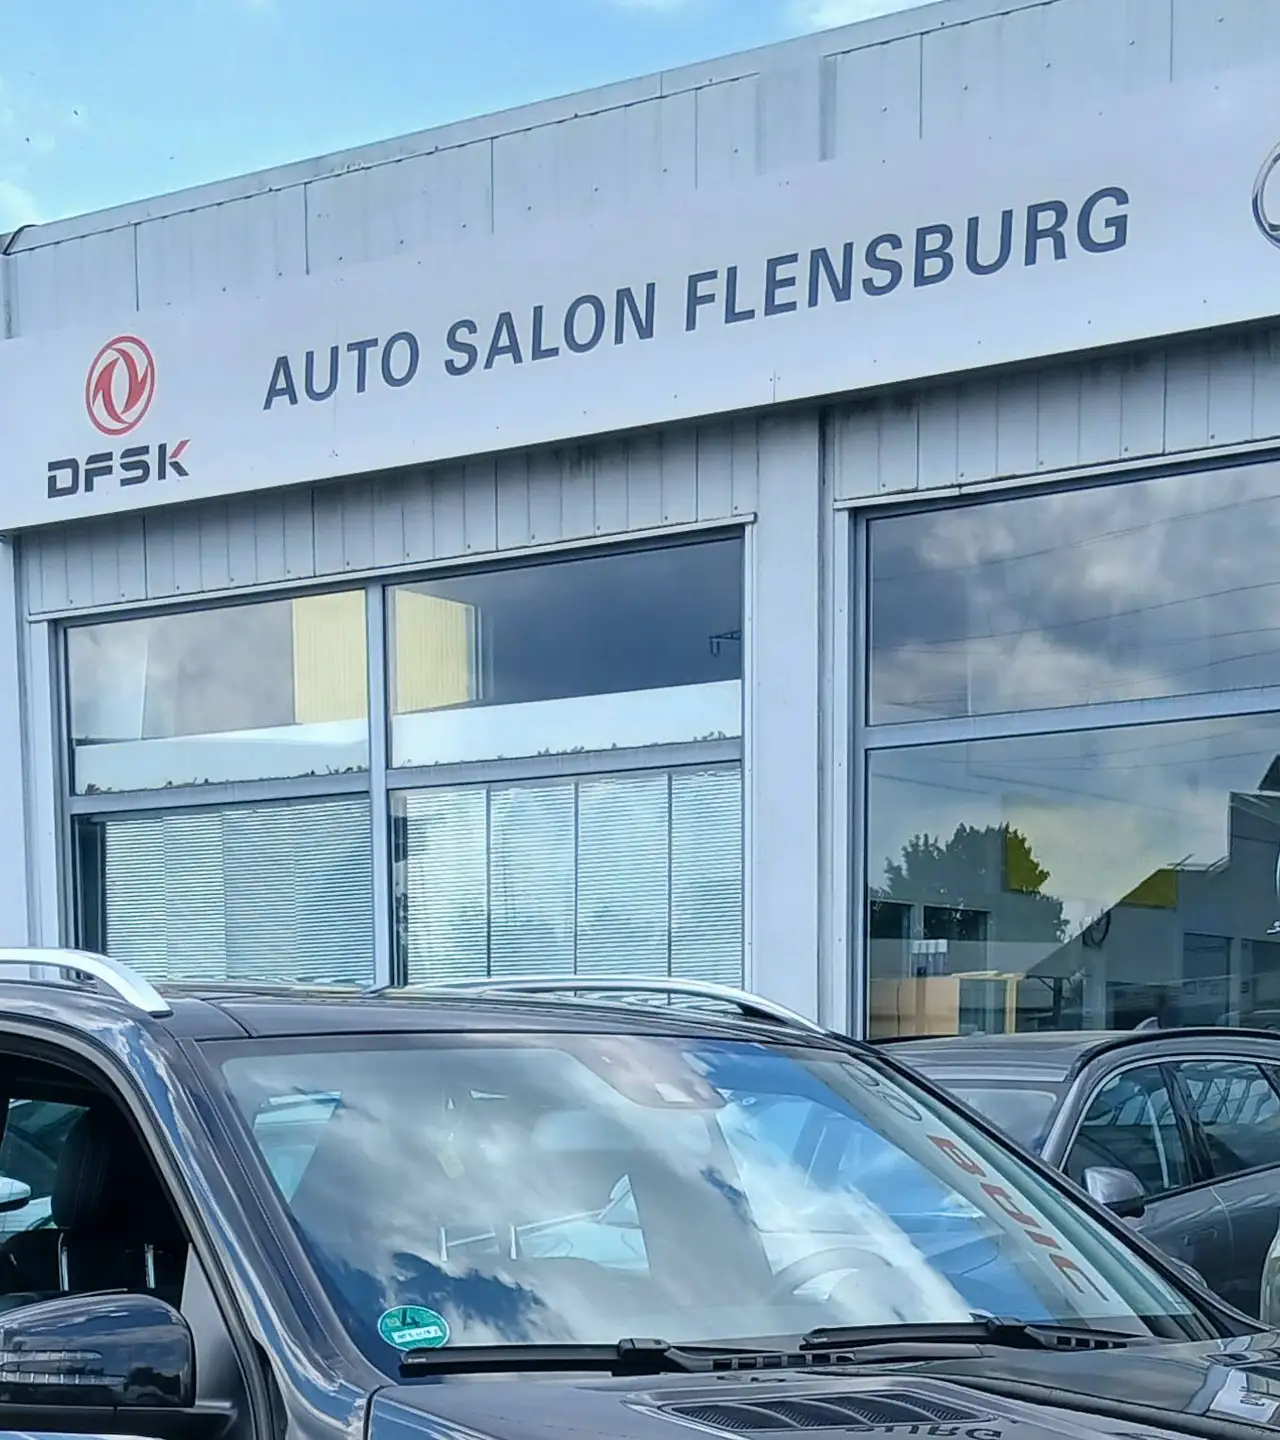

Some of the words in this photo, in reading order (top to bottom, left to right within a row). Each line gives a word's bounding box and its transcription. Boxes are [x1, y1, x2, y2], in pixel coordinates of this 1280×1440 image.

[264, 331, 419, 411] AUTO
[444, 282, 656, 377] SALON
[686, 186, 1130, 332] FLENSBURG
[47, 439, 191, 499] DFSK
